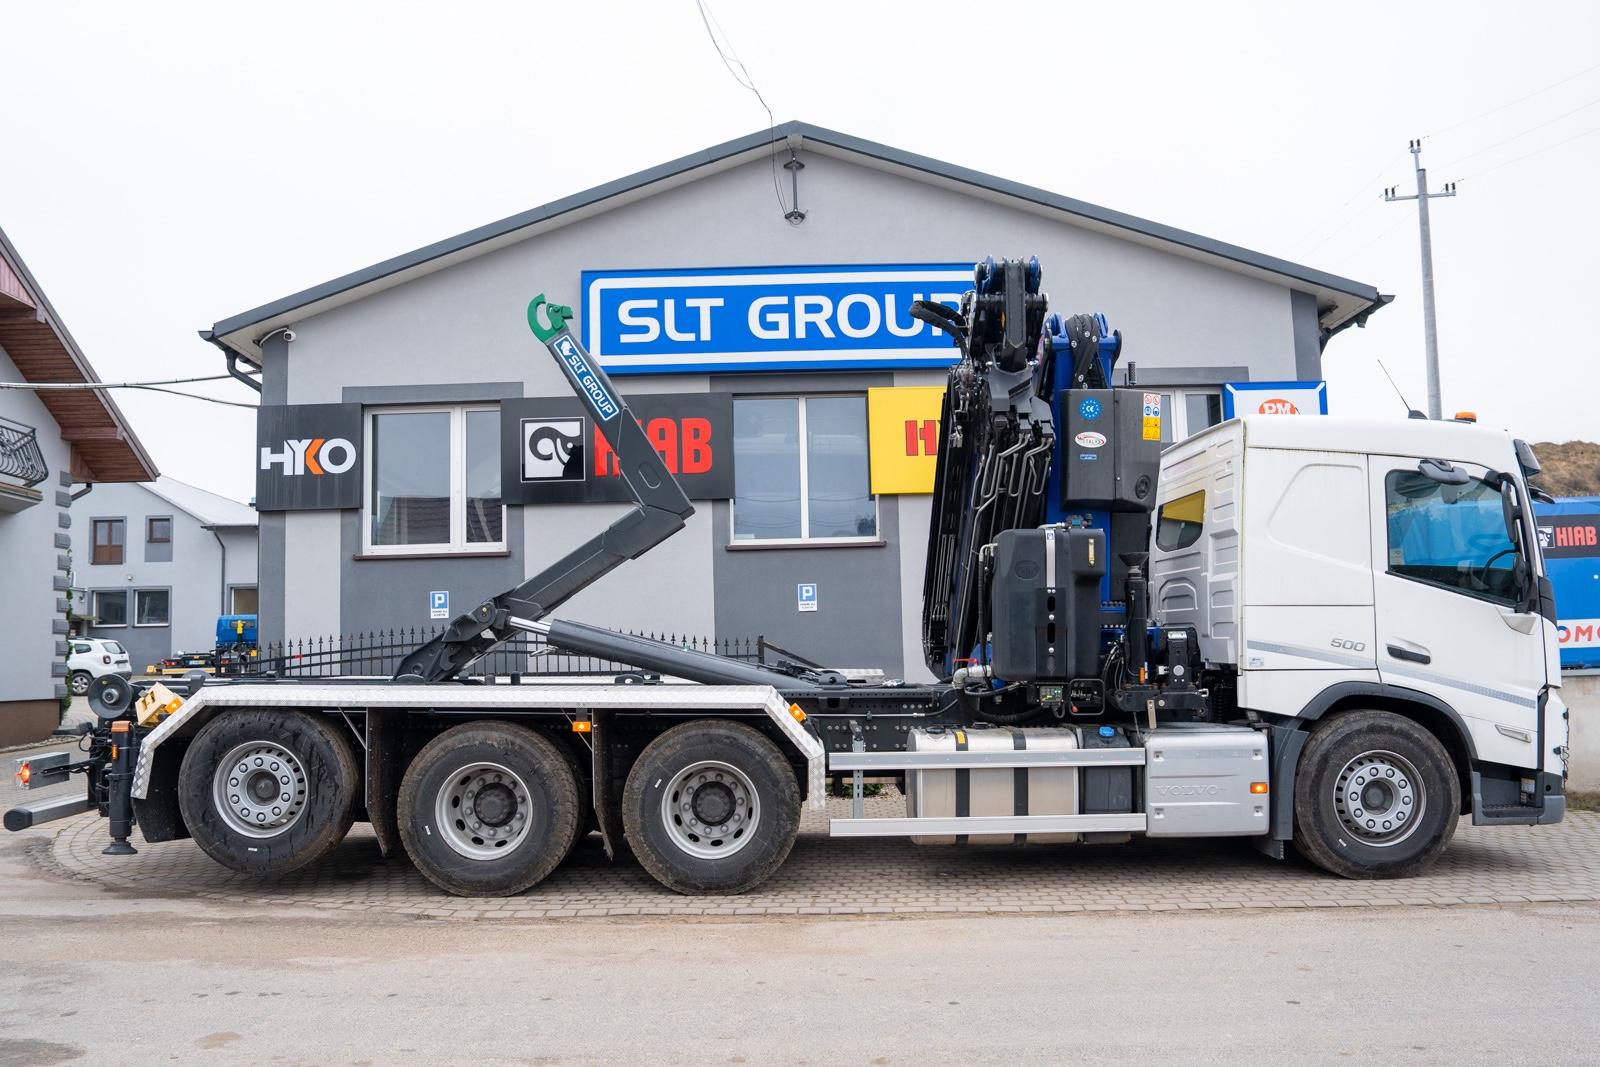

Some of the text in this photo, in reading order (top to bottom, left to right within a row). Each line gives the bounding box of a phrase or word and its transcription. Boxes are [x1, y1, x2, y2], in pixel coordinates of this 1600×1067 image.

[618, 297, 724, 343] SLT
[568, 355, 613, 413] SLT GROUP
[260, 437, 357, 476] HYKO
[594, 417, 713, 477] HAB
[1555, 525, 1597, 548] HIAB
[434, 592, 446, 608] P
[802, 585, 813, 601] P
[1556, 623, 1600, 644] OM
[1330, 637, 1366, 653] 500
[1154, 783, 1219, 797] VOLVO
